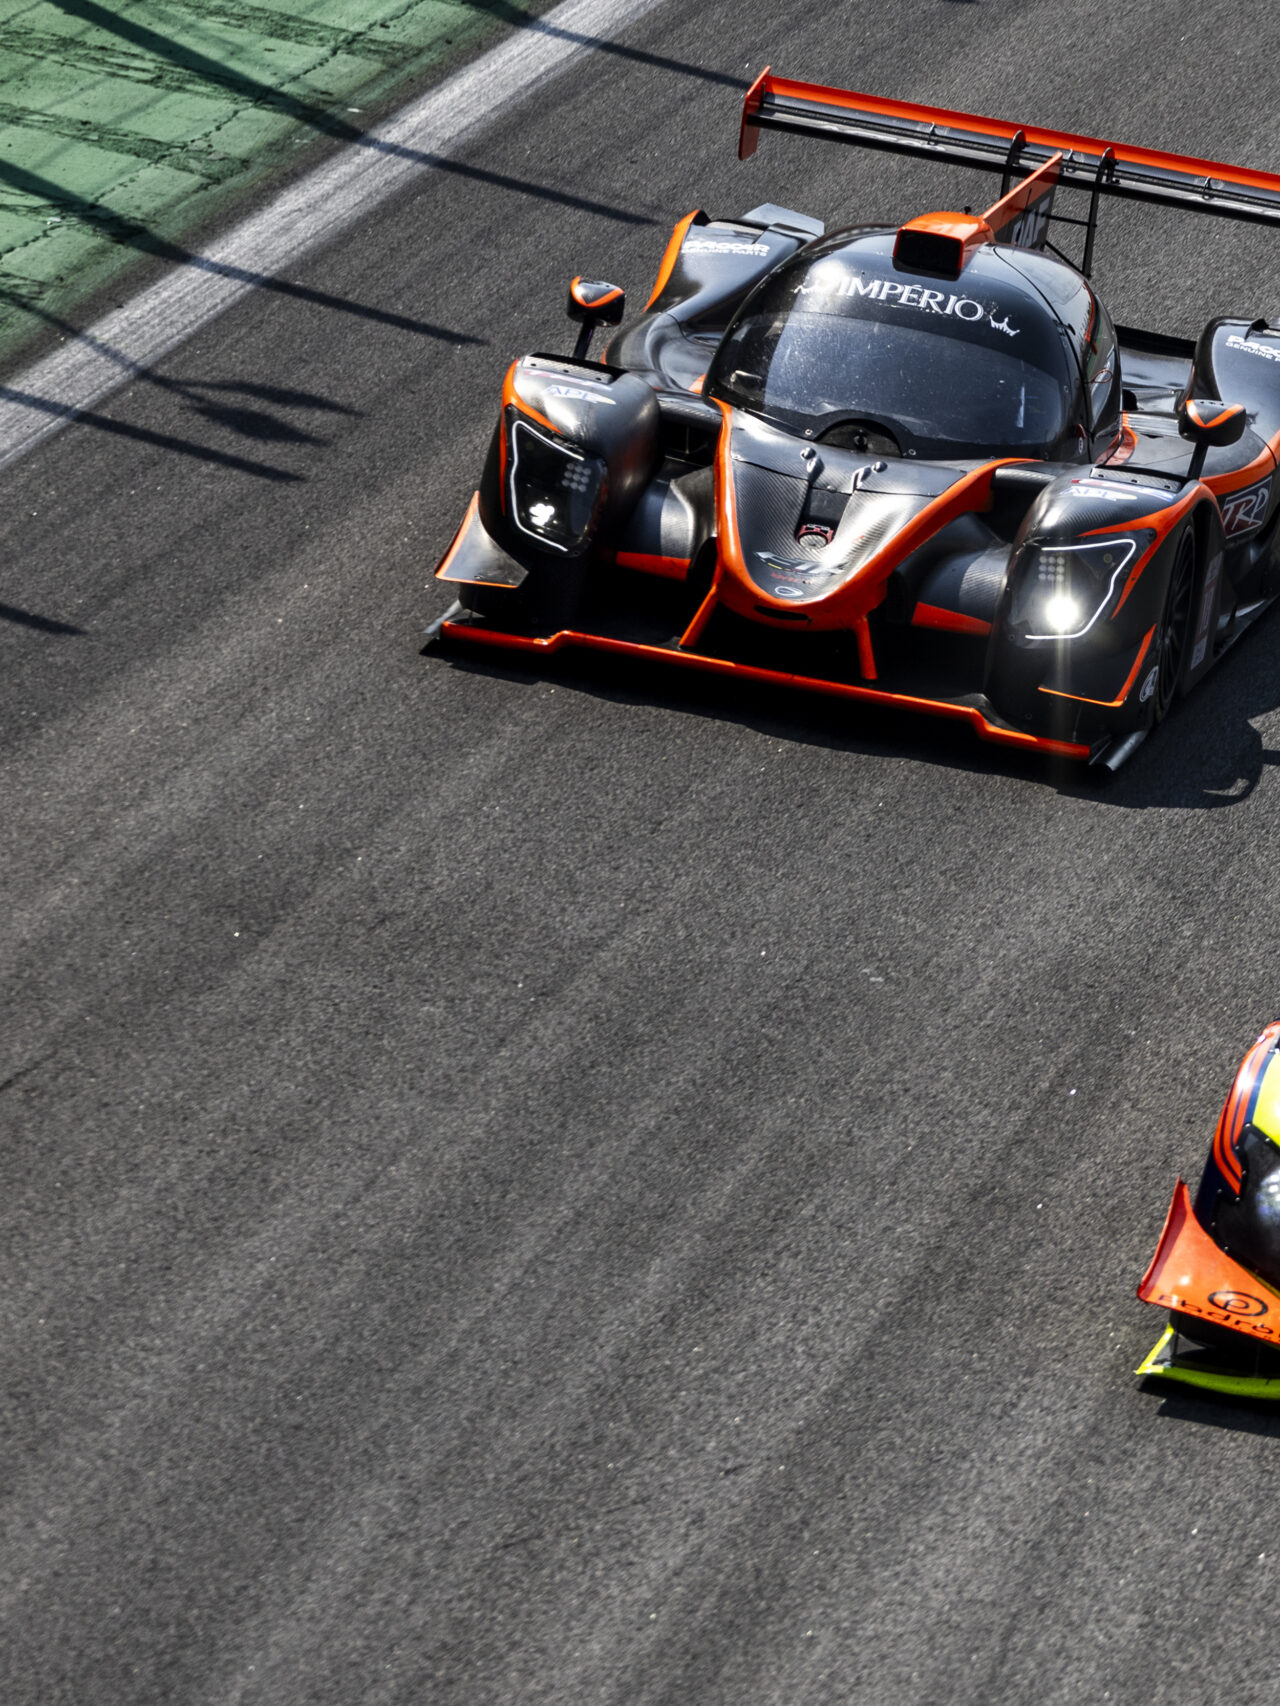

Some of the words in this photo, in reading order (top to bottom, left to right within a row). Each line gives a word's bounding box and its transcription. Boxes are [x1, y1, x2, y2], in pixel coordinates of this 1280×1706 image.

[731, 248, 768, 257] PARTS
[837, 276, 984, 321] IMPÉRIO
[1225, 341, 1273, 360] GENUINE
